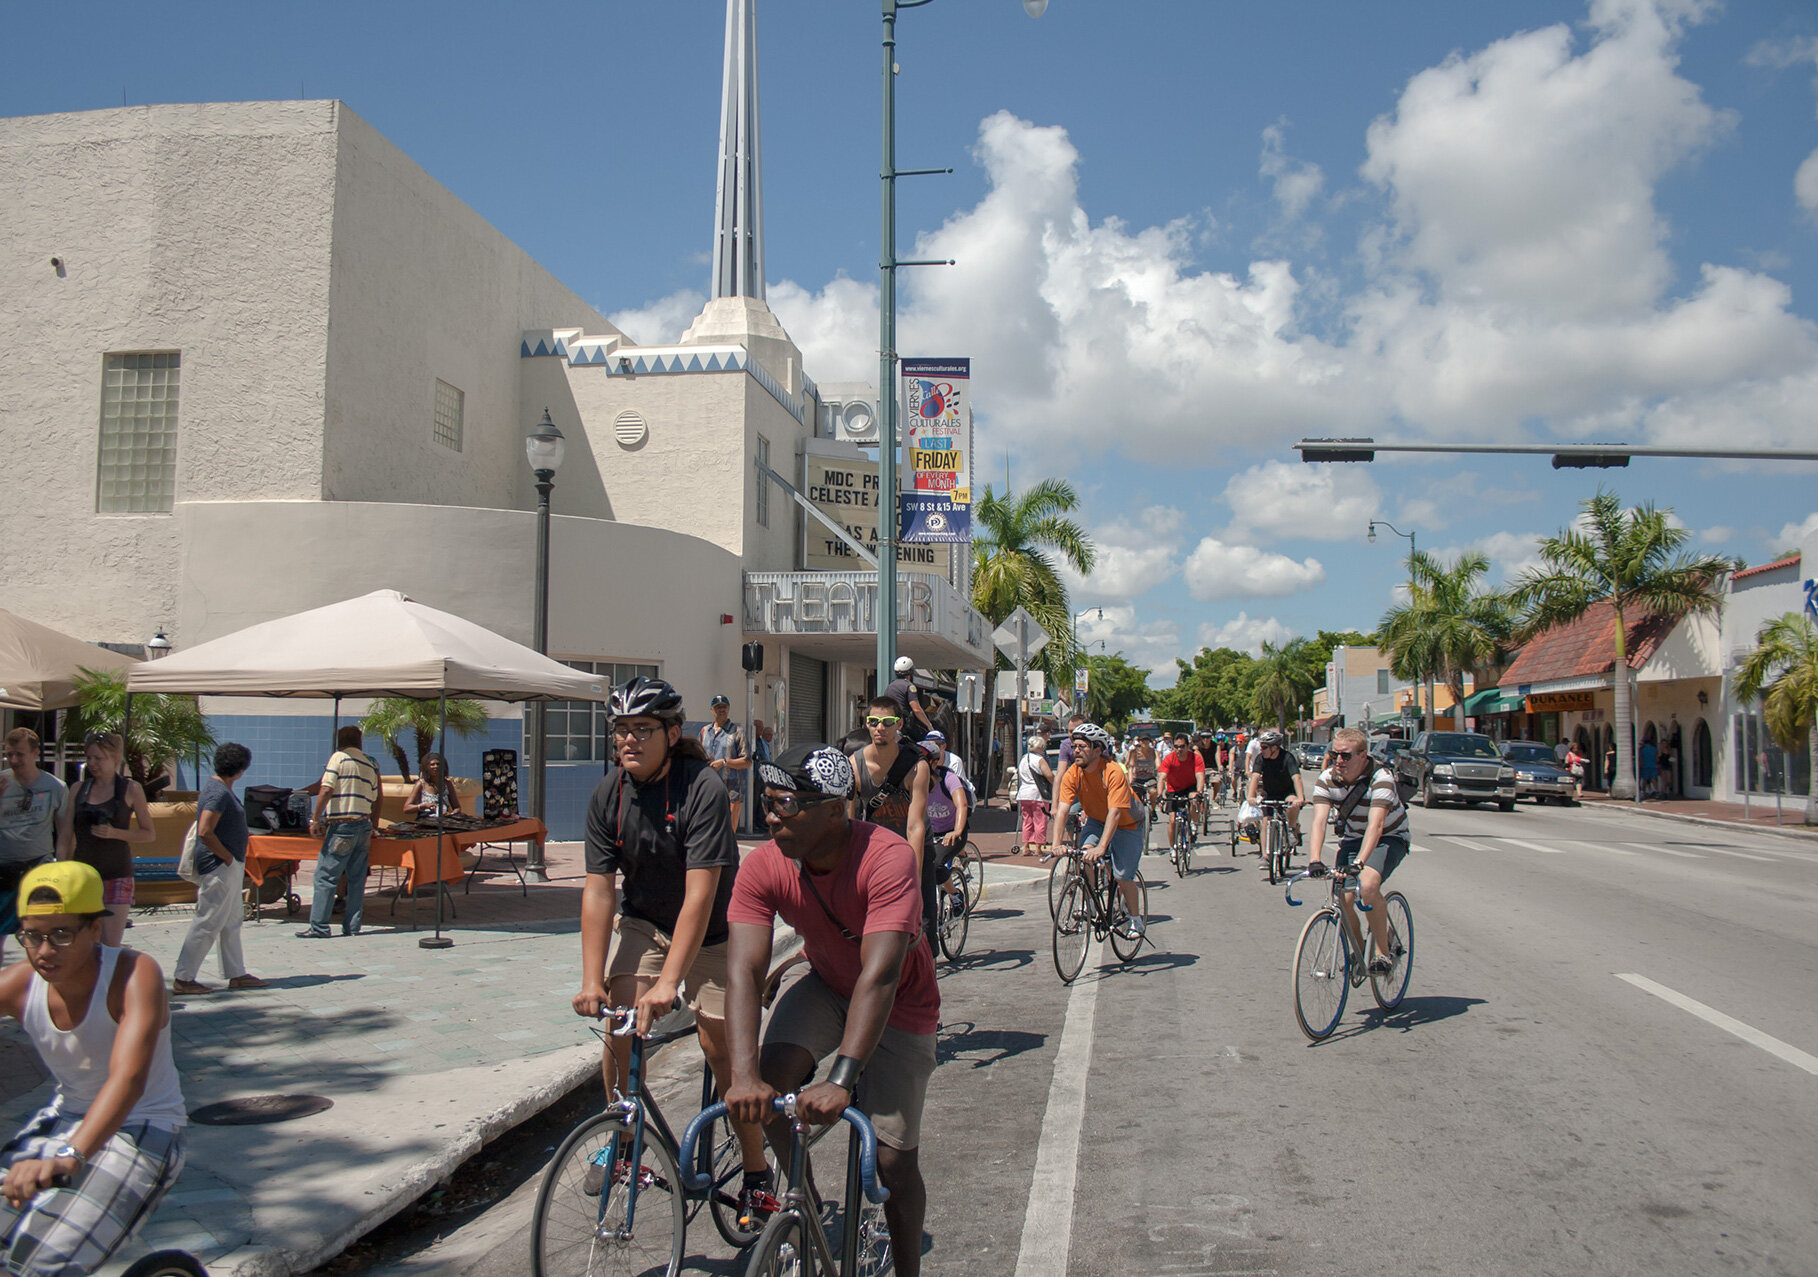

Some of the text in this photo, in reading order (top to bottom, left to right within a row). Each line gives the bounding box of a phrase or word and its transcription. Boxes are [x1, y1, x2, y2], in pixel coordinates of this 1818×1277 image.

[909, 378, 920, 418] VIERNES
[909, 418, 962, 428] CULTURALES
[932, 427, 962, 436] FESTIVAL
[924, 438, 948, 449] LAST
[916, 451, 957, 470] FRIDAY
[824, 470, 854, 488] MDC
[916, 471, 949, 480] OF EVERY
[927, 477, 957, 490] MONTH
[809, 486, 869, 507] CELESTE
[906, 502, 919, 512] SW
[919, 502, 925, 512] 8
[926, 502, 935, 512] St
[952, 503, 967, 512] Ave
[825, 541, 852, 557] THE
